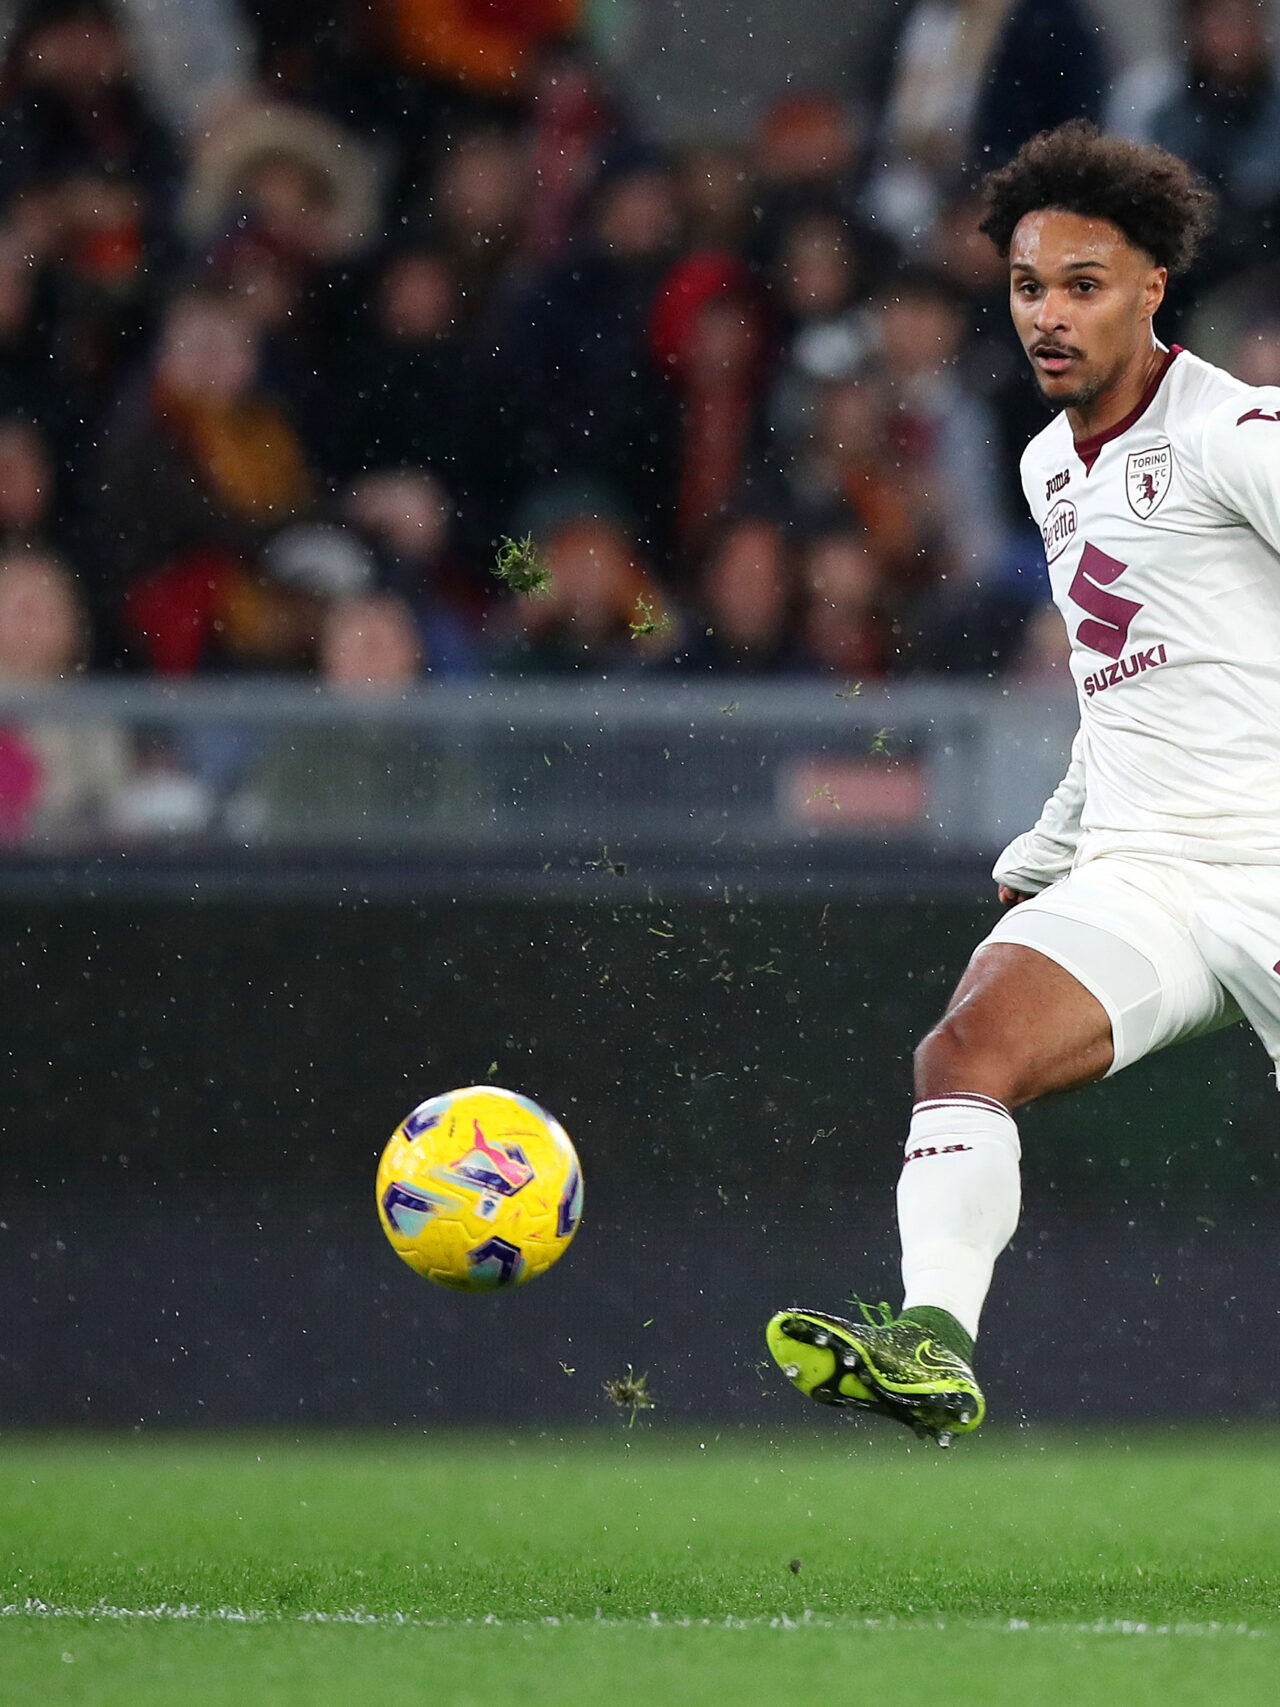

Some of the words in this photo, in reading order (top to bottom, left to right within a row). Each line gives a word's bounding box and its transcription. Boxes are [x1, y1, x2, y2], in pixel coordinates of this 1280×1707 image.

[1132, 453, 1167, 469] TORINO
[1046, 468, 1071, 502] Joma
[1083, 643, 1167, 698] SUZUKI
